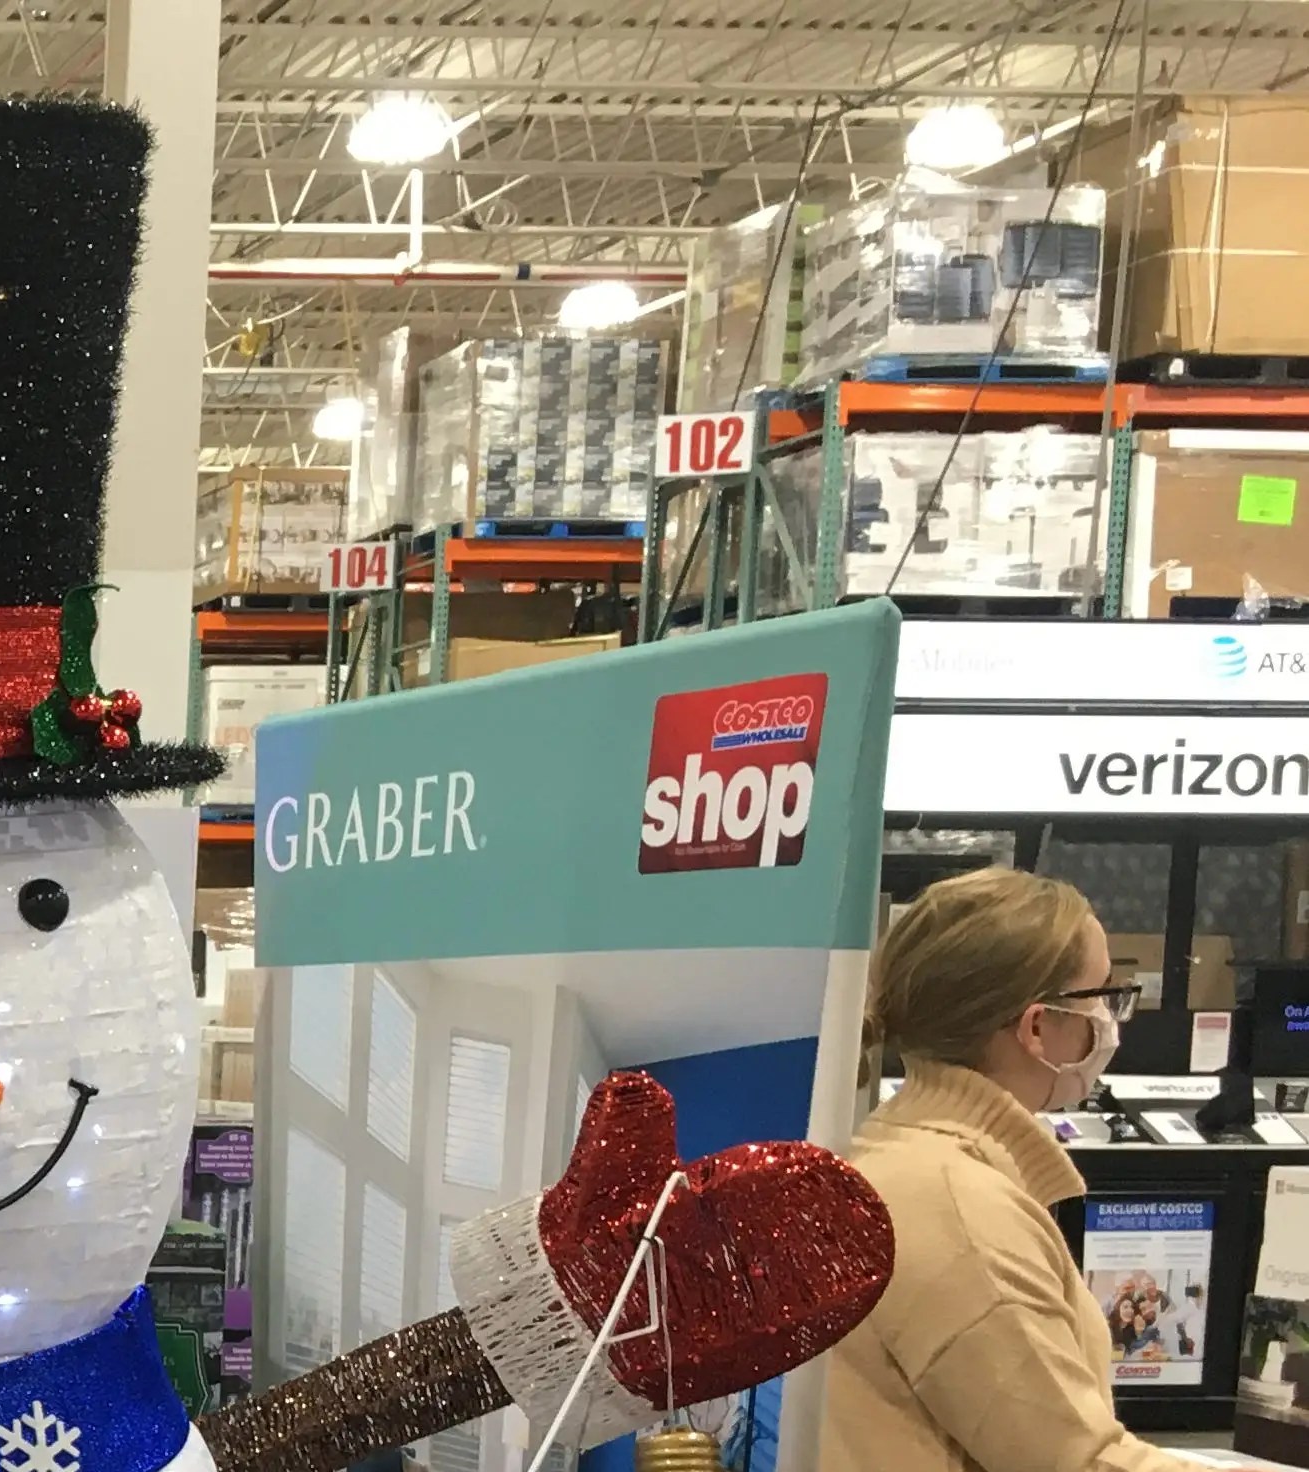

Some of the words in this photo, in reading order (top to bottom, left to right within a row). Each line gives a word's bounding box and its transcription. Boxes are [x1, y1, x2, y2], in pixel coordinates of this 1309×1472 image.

[665, 417, 744, 473] 102
[328, 546, 388, 589] 104
[714, 695, 814, 735] COSTCO
[1059, 738, 1309, 796] verizon
[265, 770, 477, 873] GRABER
[641, 753, 814, 867] shop
[1099, 1203, 1156, 1215] EXCLUSIVE
[1159, 1203, 1203, 1215] COSTCO
